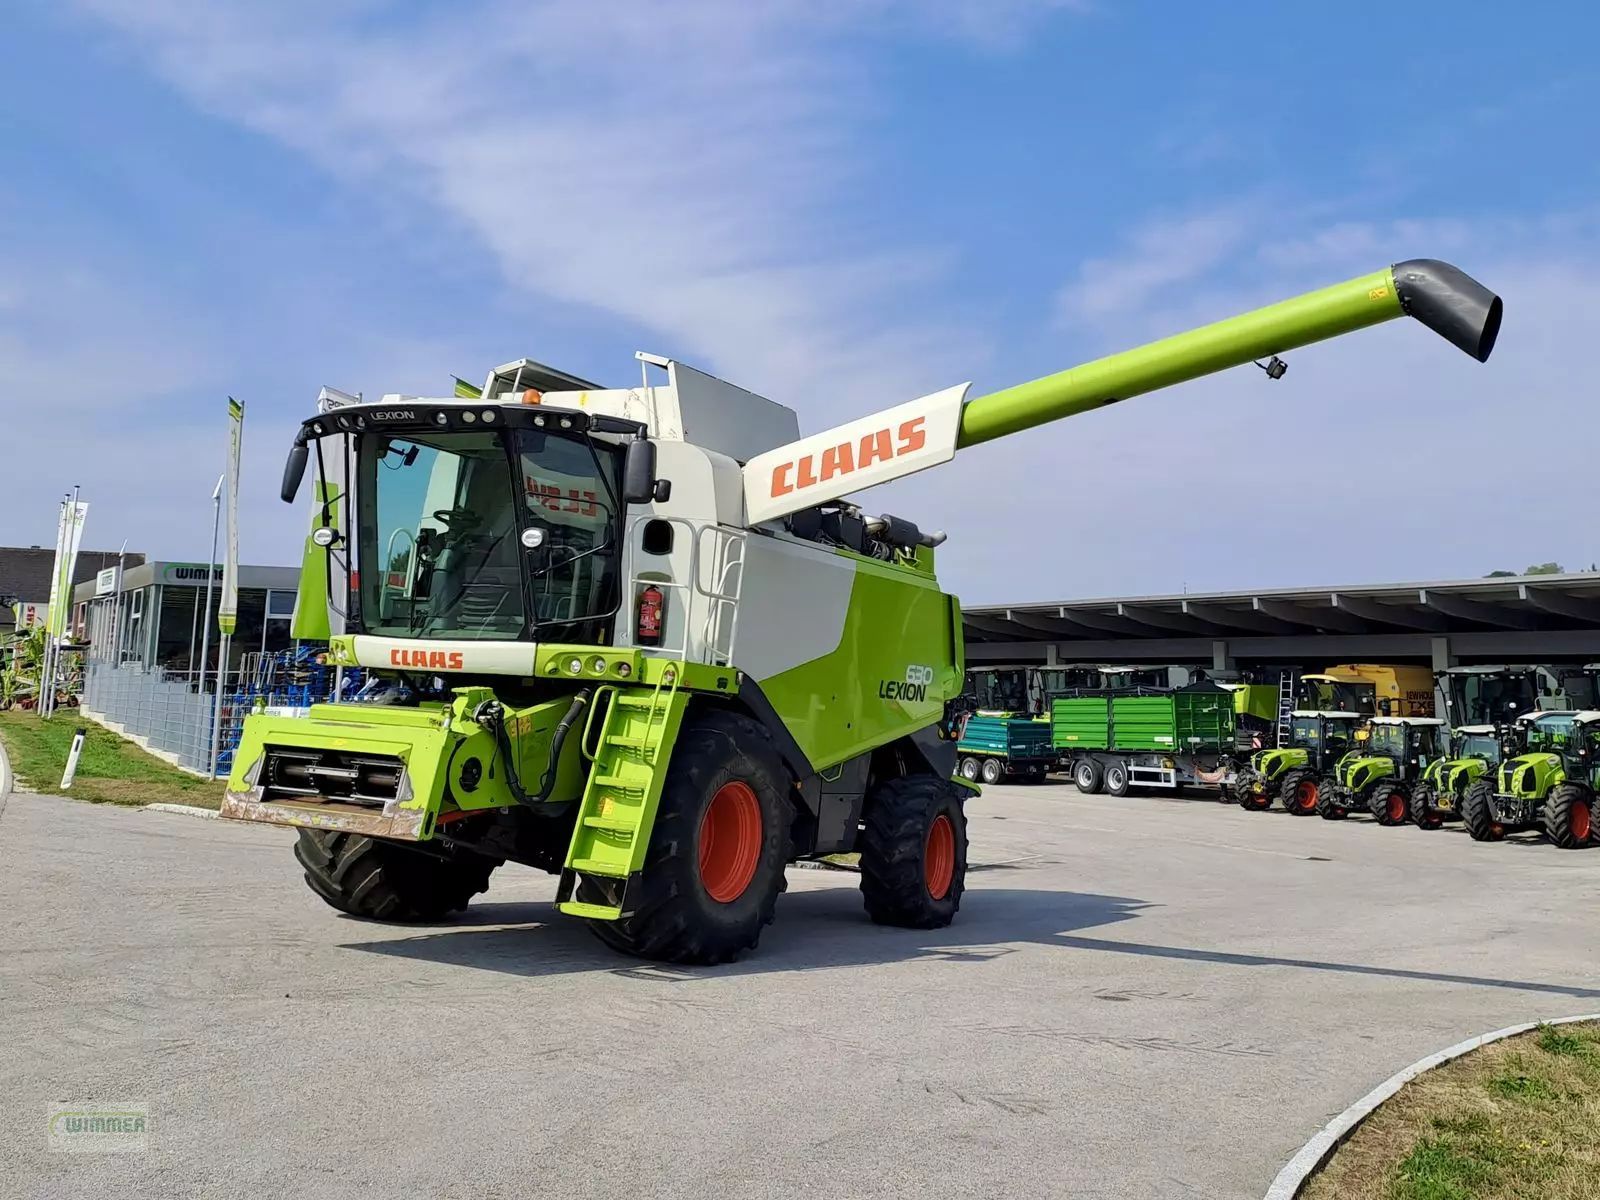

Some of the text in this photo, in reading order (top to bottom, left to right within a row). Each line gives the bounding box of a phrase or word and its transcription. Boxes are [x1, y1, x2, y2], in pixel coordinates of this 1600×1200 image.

[370, 410, 415, 421] LEXION
[770, 415, 926, 498] CLAAS
[390, 649, 464, 670] CLAAS
[879, 679, 927, 703] LEXION
